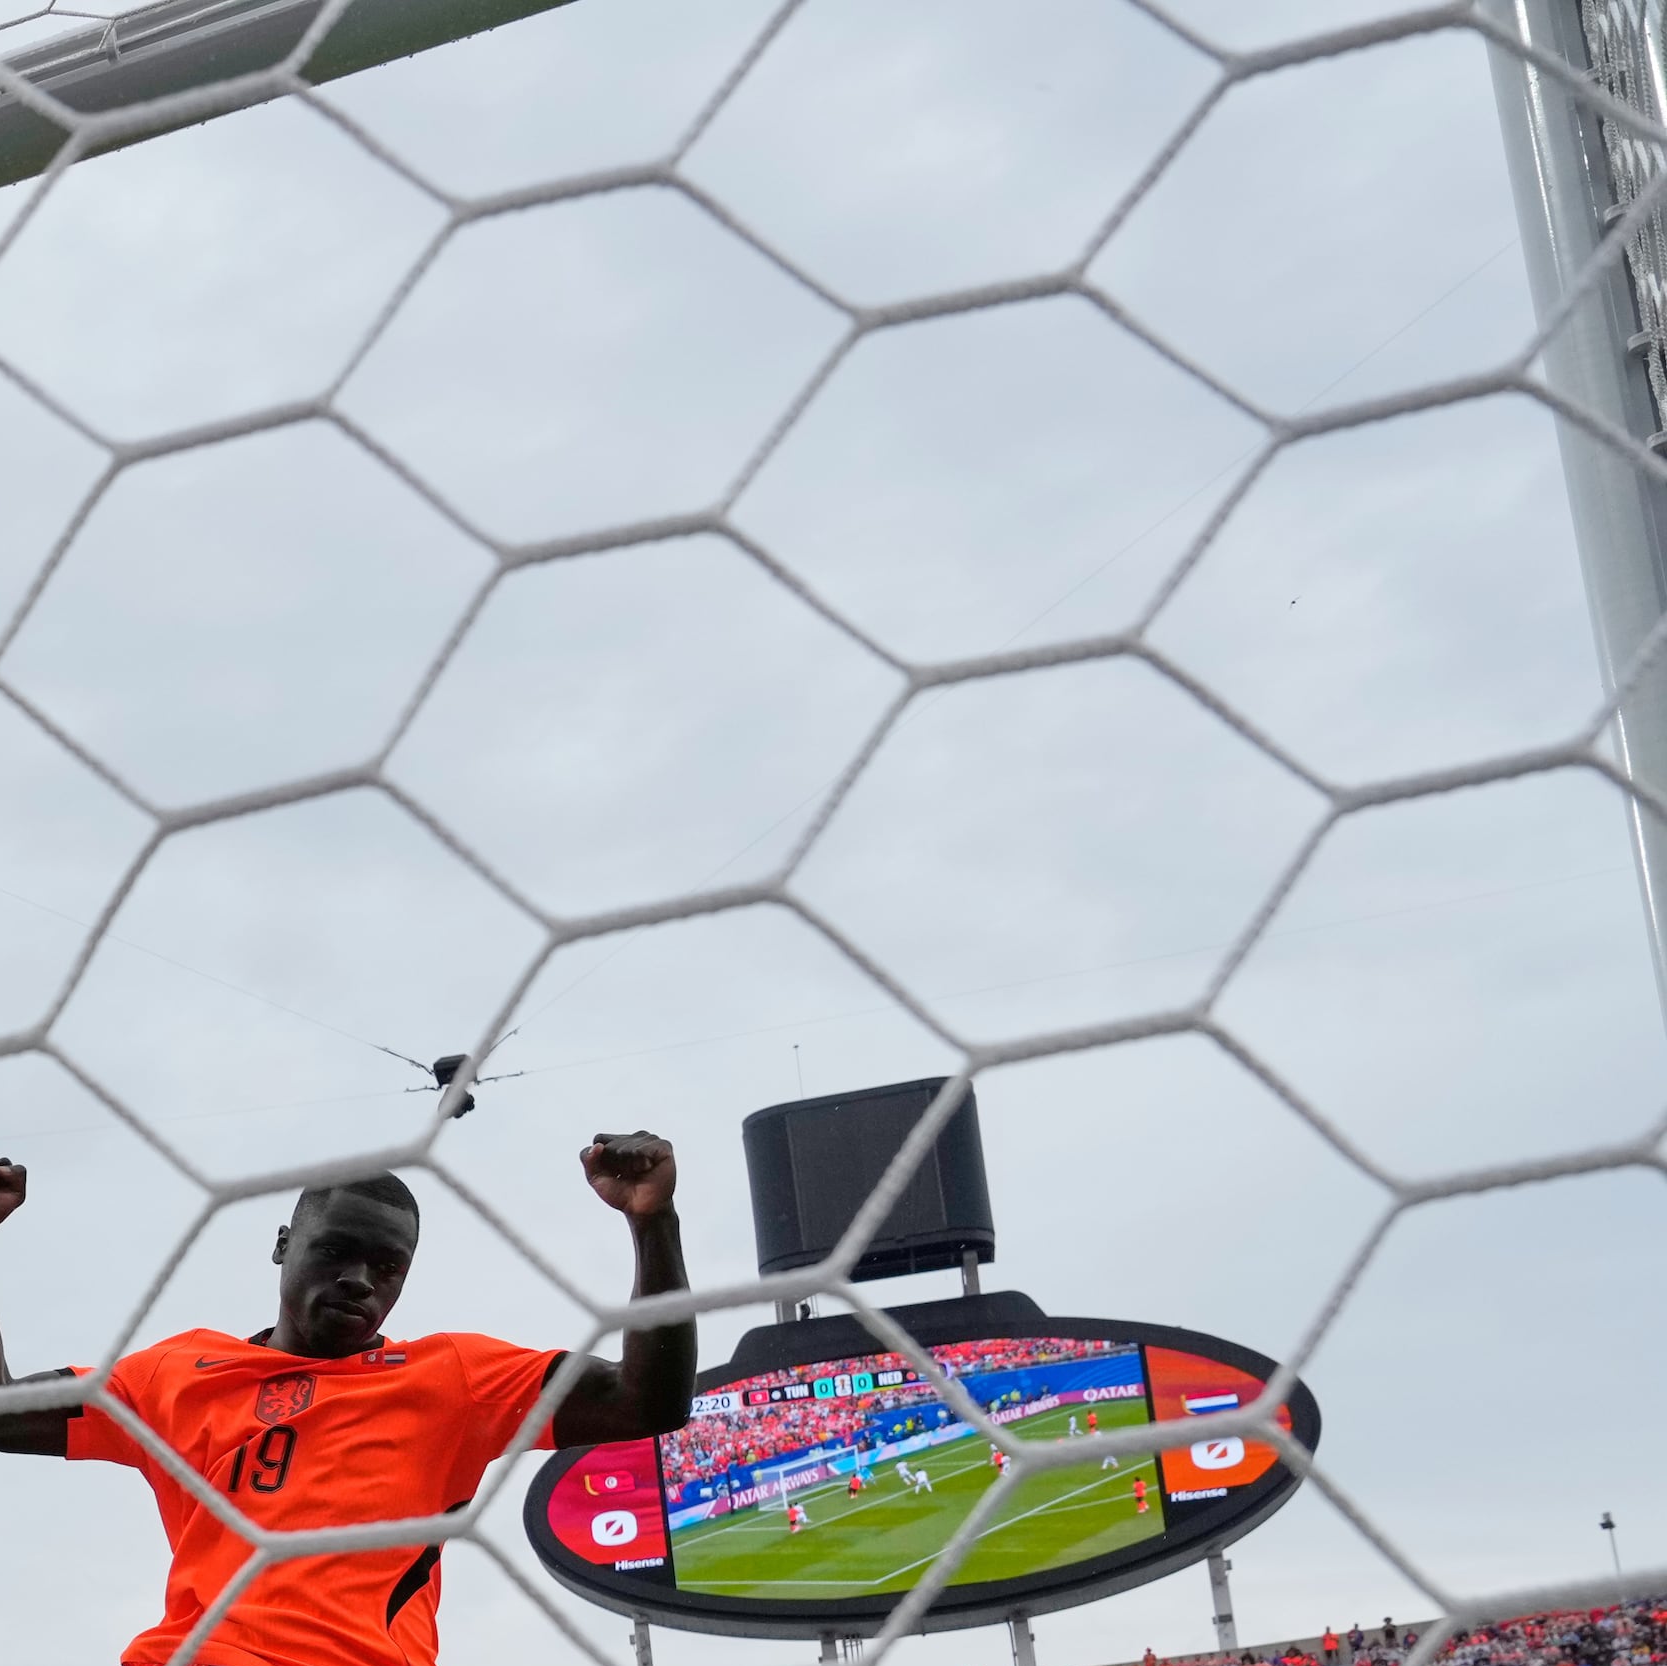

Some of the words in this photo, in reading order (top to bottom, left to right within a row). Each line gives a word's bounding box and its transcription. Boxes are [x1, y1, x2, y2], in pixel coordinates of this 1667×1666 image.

[784, 1384, 809, 1400] TUN
[878, 1372, 903, 1386] NED
[1083, 1384, 1138, 1402] QATAR
[228, 1424, 297, 1494] 19
[1171, 1488, 1228, 1503] Hisense
[614, 1556, 664, 1572] Hisense
